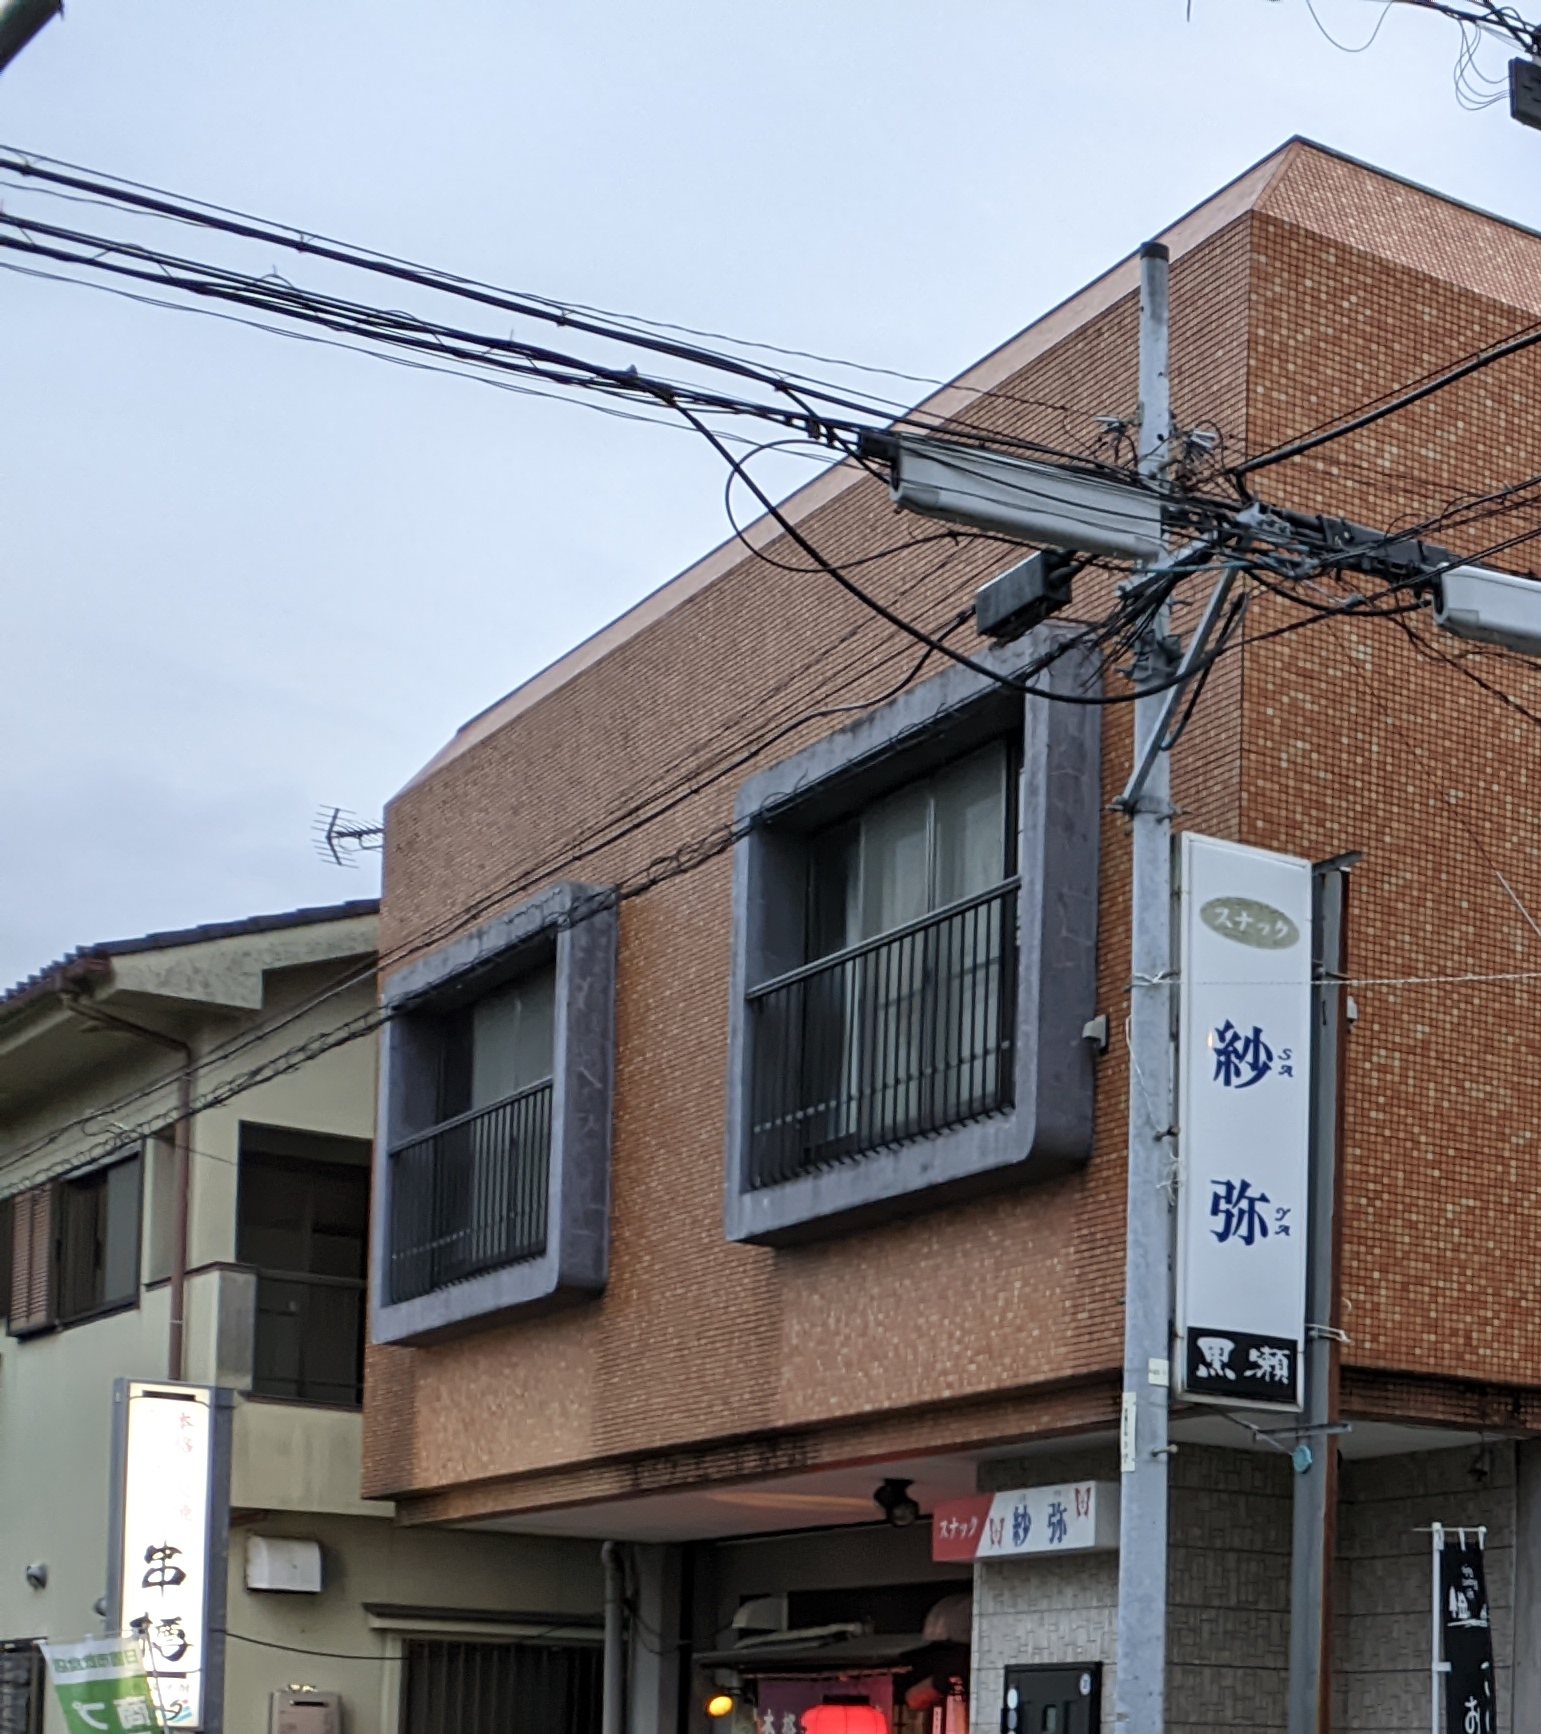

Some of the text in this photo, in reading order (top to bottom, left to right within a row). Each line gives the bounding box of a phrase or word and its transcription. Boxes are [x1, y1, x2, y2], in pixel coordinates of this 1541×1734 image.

[1214, 906, 1289, 939] スナック
[1210, 1019, 1274, 1247] 紗弥
[939, 1515, 979, 1540] スナック
[1011, 1501, 1068, 1548] 紗弥
